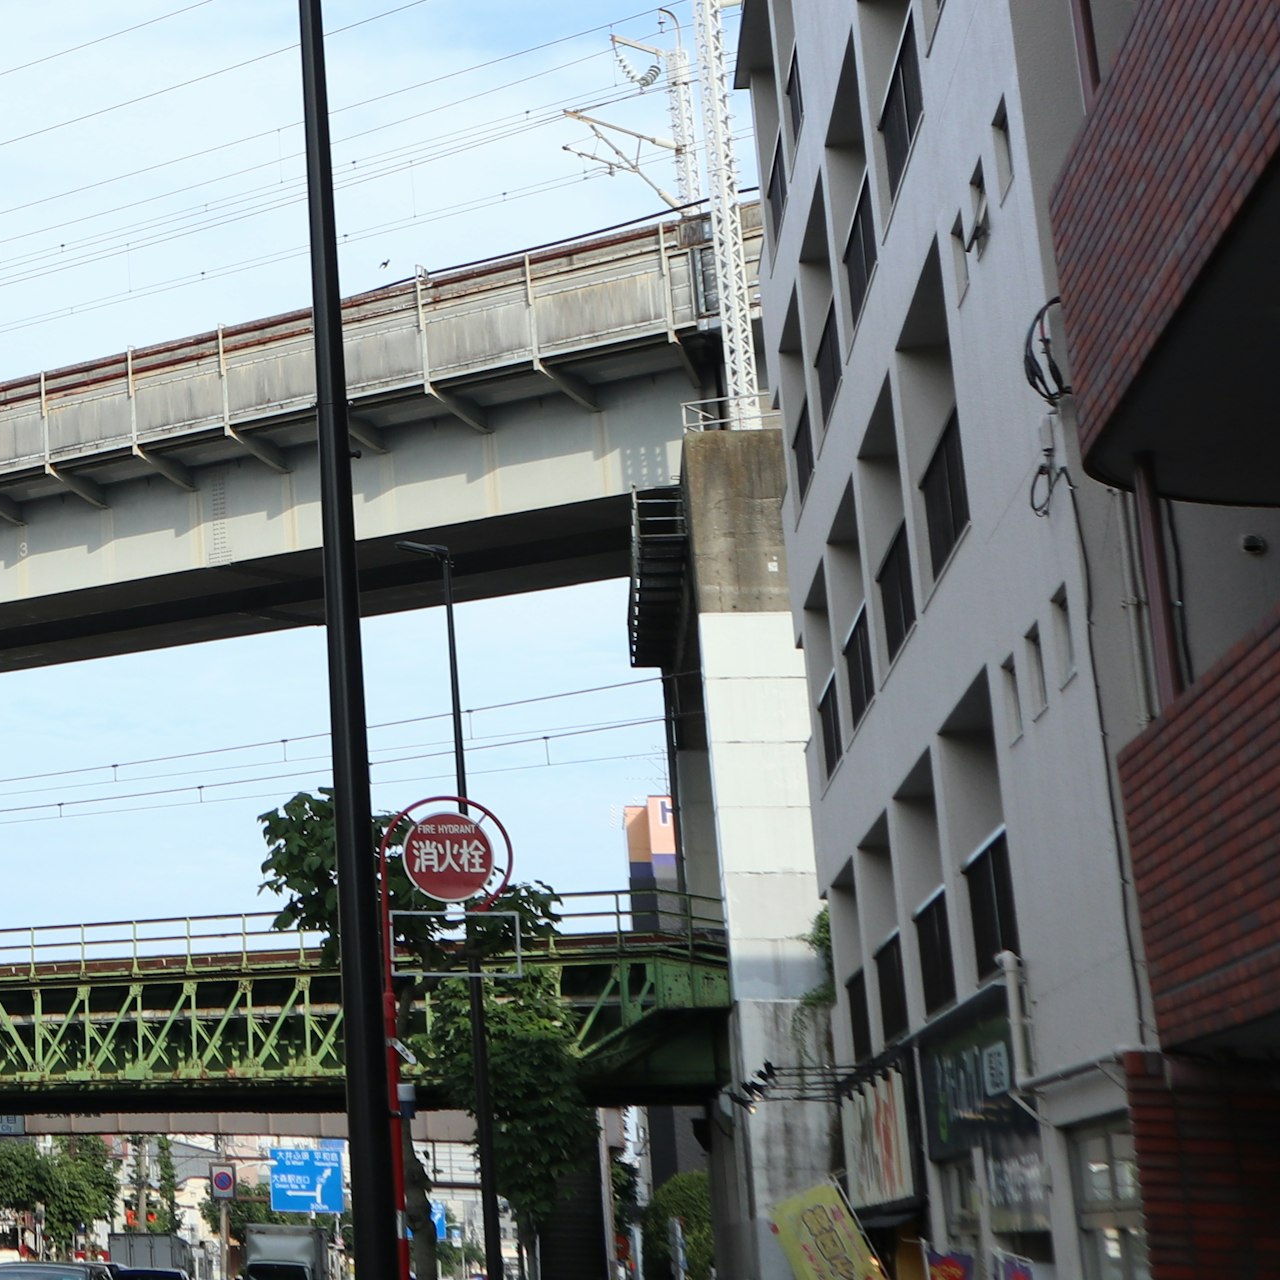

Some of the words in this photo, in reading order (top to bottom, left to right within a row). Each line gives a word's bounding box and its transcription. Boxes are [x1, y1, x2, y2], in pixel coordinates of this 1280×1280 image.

[417, 824, 437, 834] FIRE
[437, 823, 477, 835] HYDRANT
[411, 839, 487, 874] 消火栓
